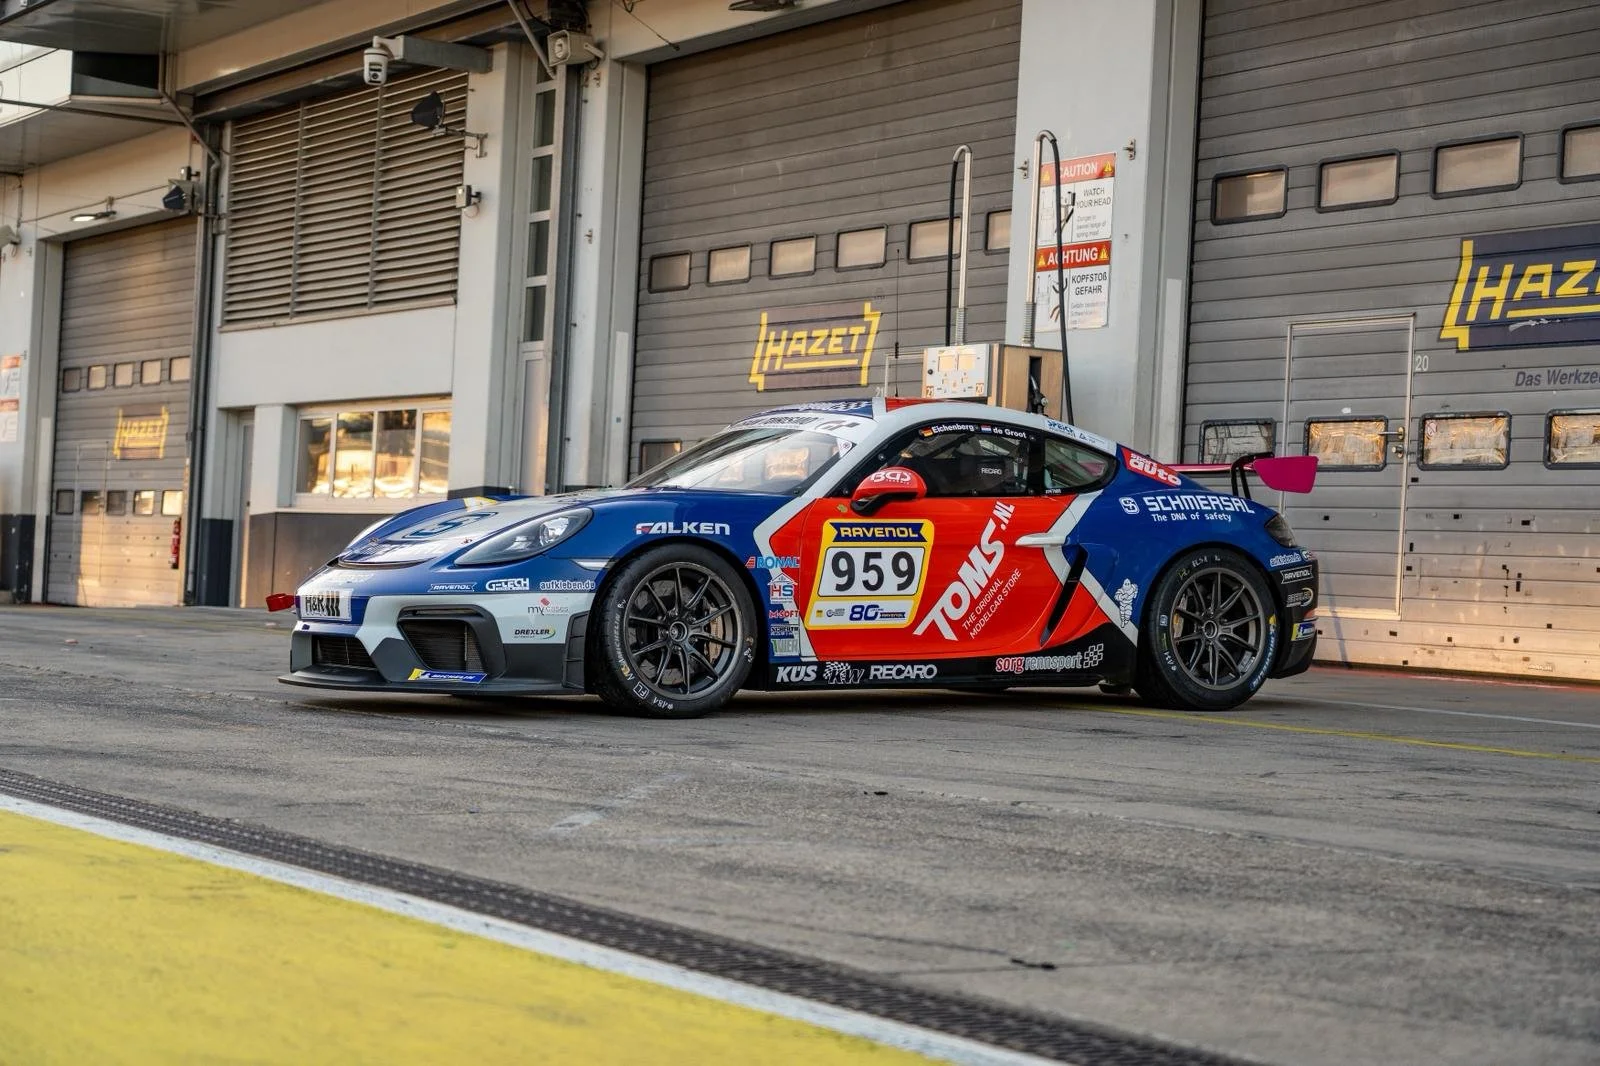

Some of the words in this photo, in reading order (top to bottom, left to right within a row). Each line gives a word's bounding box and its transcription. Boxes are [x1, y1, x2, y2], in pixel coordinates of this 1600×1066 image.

[1083, 187, 1105, 197] WATCH
[1076, 199, 1093, 209] YOUR
[1093, 196, 1112, 207] HEAD
[1075, 285, 1103, 296] GEFAHR
[1466, 260, 1600, 322] HAZ
[762, 325, 866, 371] HAZET
[1414, 354, 1430, 372] 20
[1514, 371, 1541, 387] Das
[1547, 367, 1600, 386] Werkze
[931, 424, 975, 434] Eichenberg
[1004, 428, 1027, 440] Groot
[1129, 457, 1182, 487] auto
[1142, 495, 1256, 514] SCHMERSAL
[1152, 513, 1168, 522] The
[1191, 512, 1200, 520] of
[1205, 513, 1232, 523] safety
[635, 521, 731, 536] FALKEN
[840, 526, 919, 538] RAVENOL
[757, 556, 800, 569] RONAL
[831, 551, 916, 592] 959
[540, 580, 596, 591] aufkleben.de
[771, 584, 794, 597] HS
[305, 595, 326, 613] H&R
[848, 604, 880, 621] 80
[961, 610, 978, 631] THE
[975, 577, 1004, 614] ORIGINAL
[969, 594, 1006, 640] MODELCAR
[1001, 568, 1022, 597] STORE
[995, 657, 1024, 674] sorg
[1024, 652, 1083, 672] rennsport
[776, 665, 818, 683] KÜS
[828, 667, 865, 685] KW
[869, 664, 938, 680] RECARO
